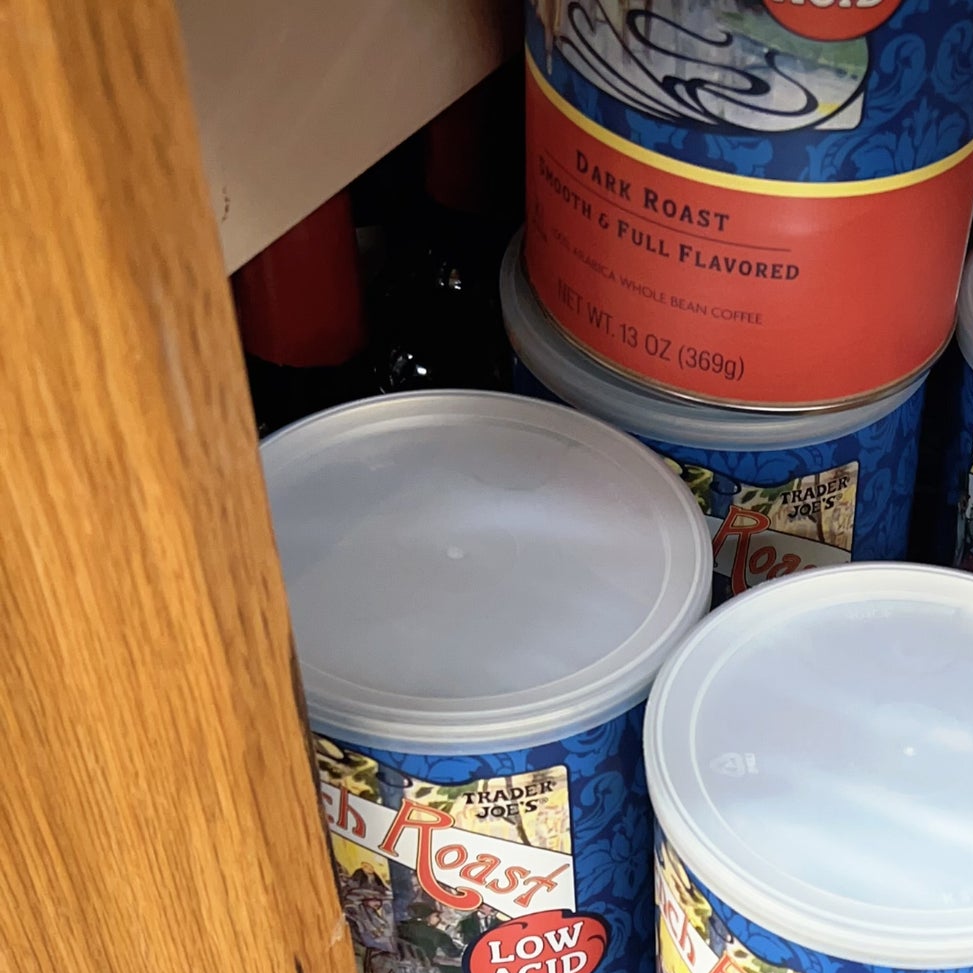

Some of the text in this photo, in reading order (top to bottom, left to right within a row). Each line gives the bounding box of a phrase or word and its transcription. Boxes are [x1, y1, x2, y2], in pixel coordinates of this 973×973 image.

[576, 150, 729, 232] DARK ROAST
[539, 156, 592, 221] SMOOTH
[598, 212, 611, 230] &
[617, 219, 670, 258] FULL
[679, 243, 800, 281] FLAVORED
[620, 275, 666, 304] WHOLE
[670, 295, 708, 317] BEAN
[711, 307, 763, 326] COFFEE
[558, 279, 746, 382] NET WT. 13 OZ (369g)
[780, 475, 849, 506] TRADER
[787, 494, 836, 520] JOE'S
[463, 780, 555, 806] TRADER
[476, 798, 540, 820] JOE'S
[379, 798, 570, 911] Roast
[488, 921, 584, 964] LOW
